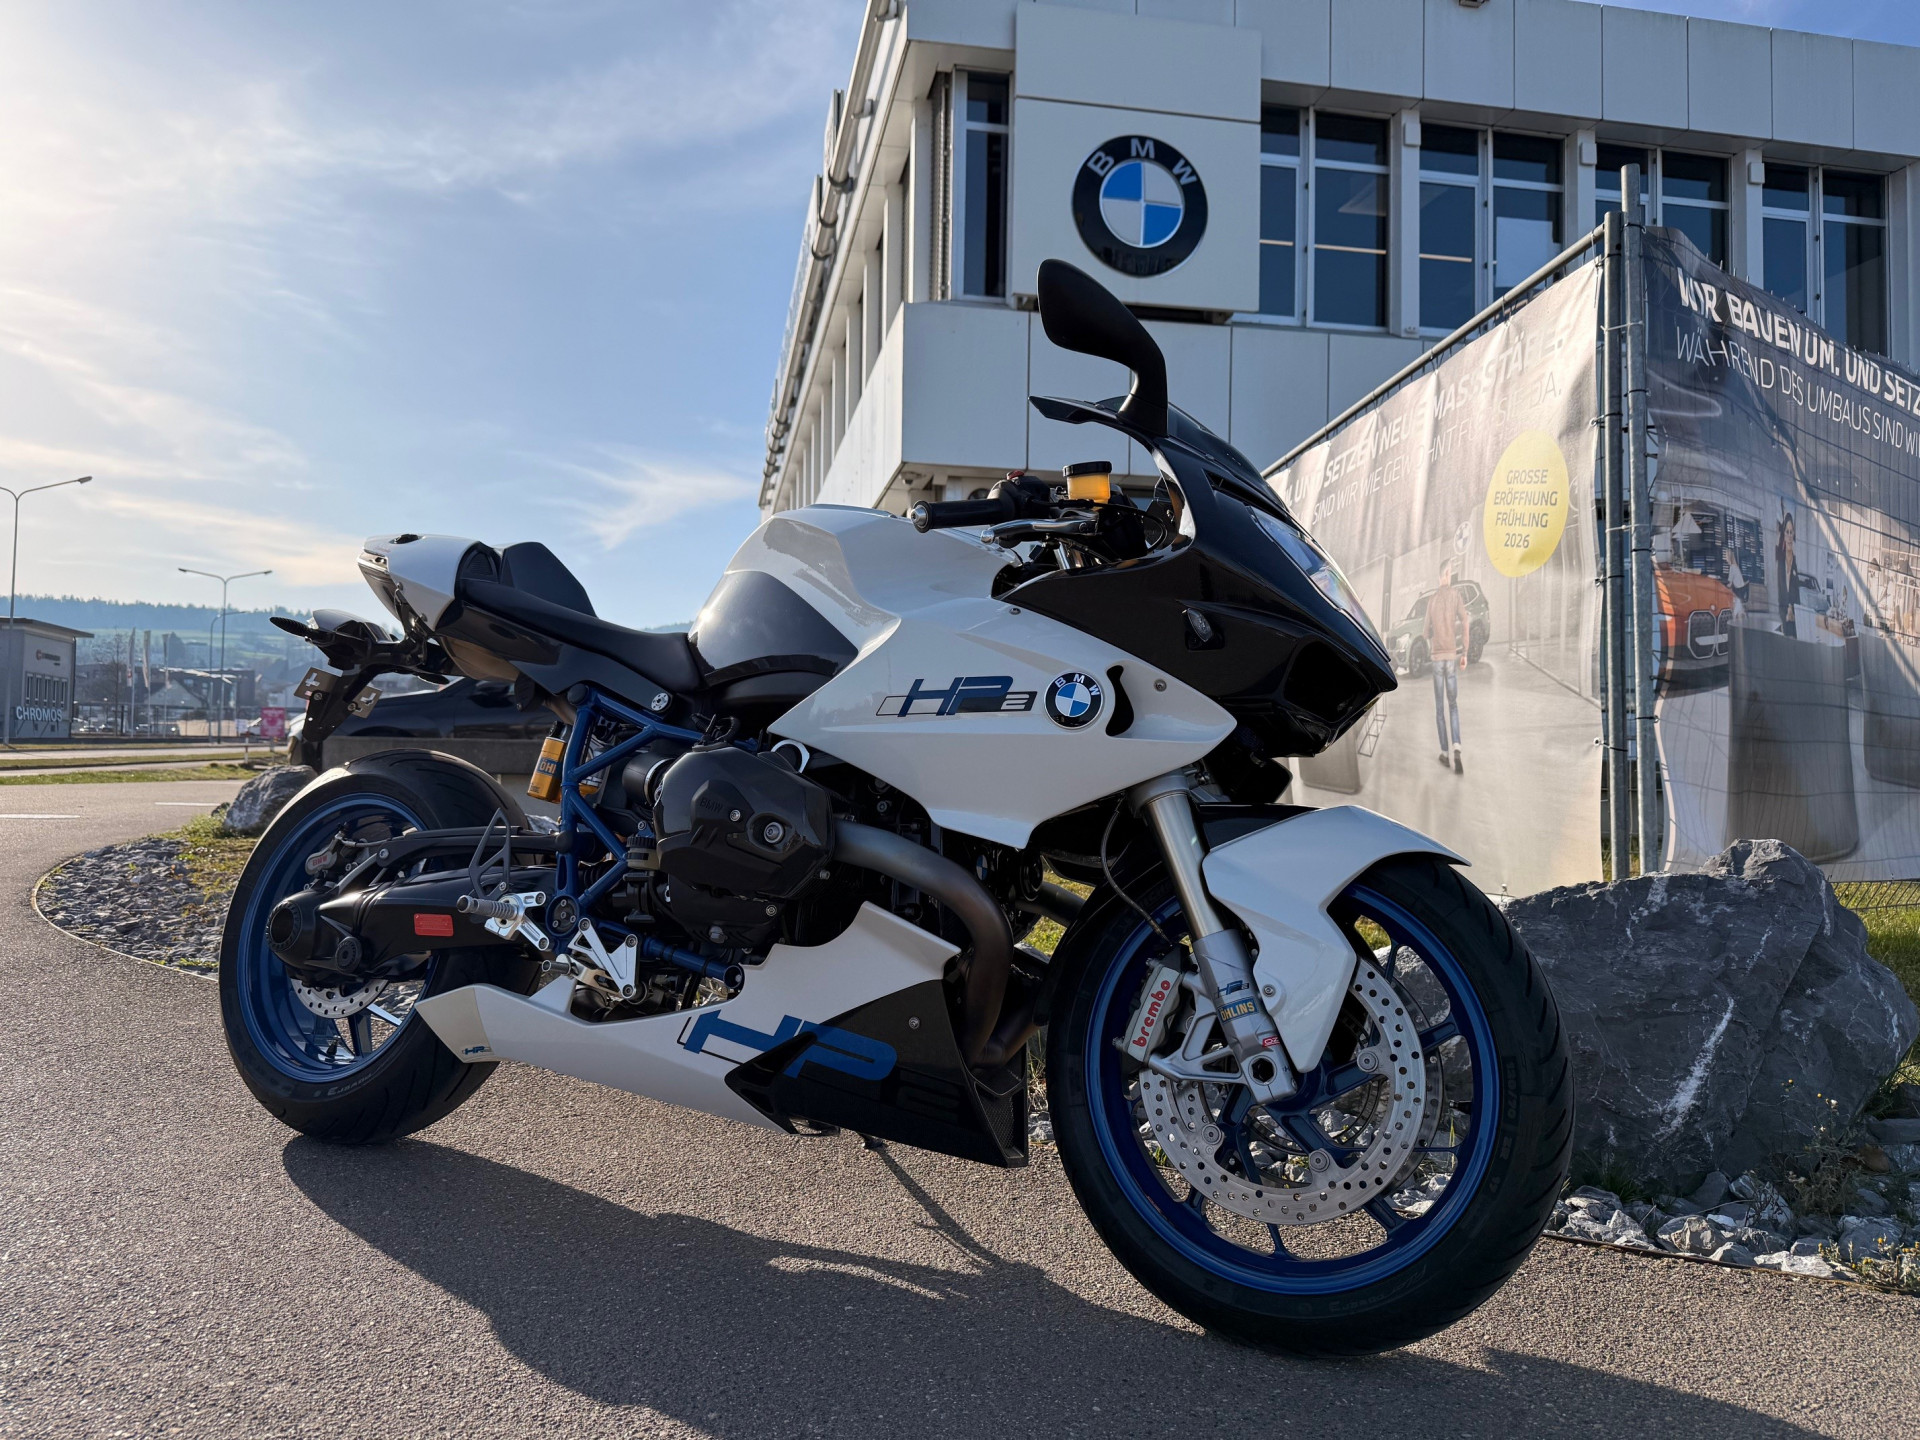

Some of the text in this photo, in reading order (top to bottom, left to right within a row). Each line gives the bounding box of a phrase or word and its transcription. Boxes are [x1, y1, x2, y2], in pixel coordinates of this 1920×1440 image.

[1087, 138, 1198, 186] BMW
[1677, 267, 1722, 322] WIR
[1725, 291, 1800, 357] BAUEN
[1804, 328, 1840, 376] UM.
[1845, 347, 1881, 394] UND
[1677, 326, 1775, 389] WÄHREND
[1780, 365, 1803, 406] DES
[1808, 382, 1871, 434] UMBAUS
[1873, 412, 1903, 448] SIND
[1324, 431, 1380, 488] SETZEN
[1506, 469, 1549, 485] GROSSE
[1312, 494, 1335, 525] SIND
[1337, 480, 1358, 511] WIR
[1360, 467, 1383, 499] WIE
[1493, 487, 1558, 506] ERÖFFNUNG
[1495, 508, 1549, 528] FRÜHLING
[1504, 532, 1530, 548] 2026
[1054, 673, 1101, 696] BMW
[16, 705, 63, 722] CHROMOS
[1132, 979, 1171, 1047] brembo
